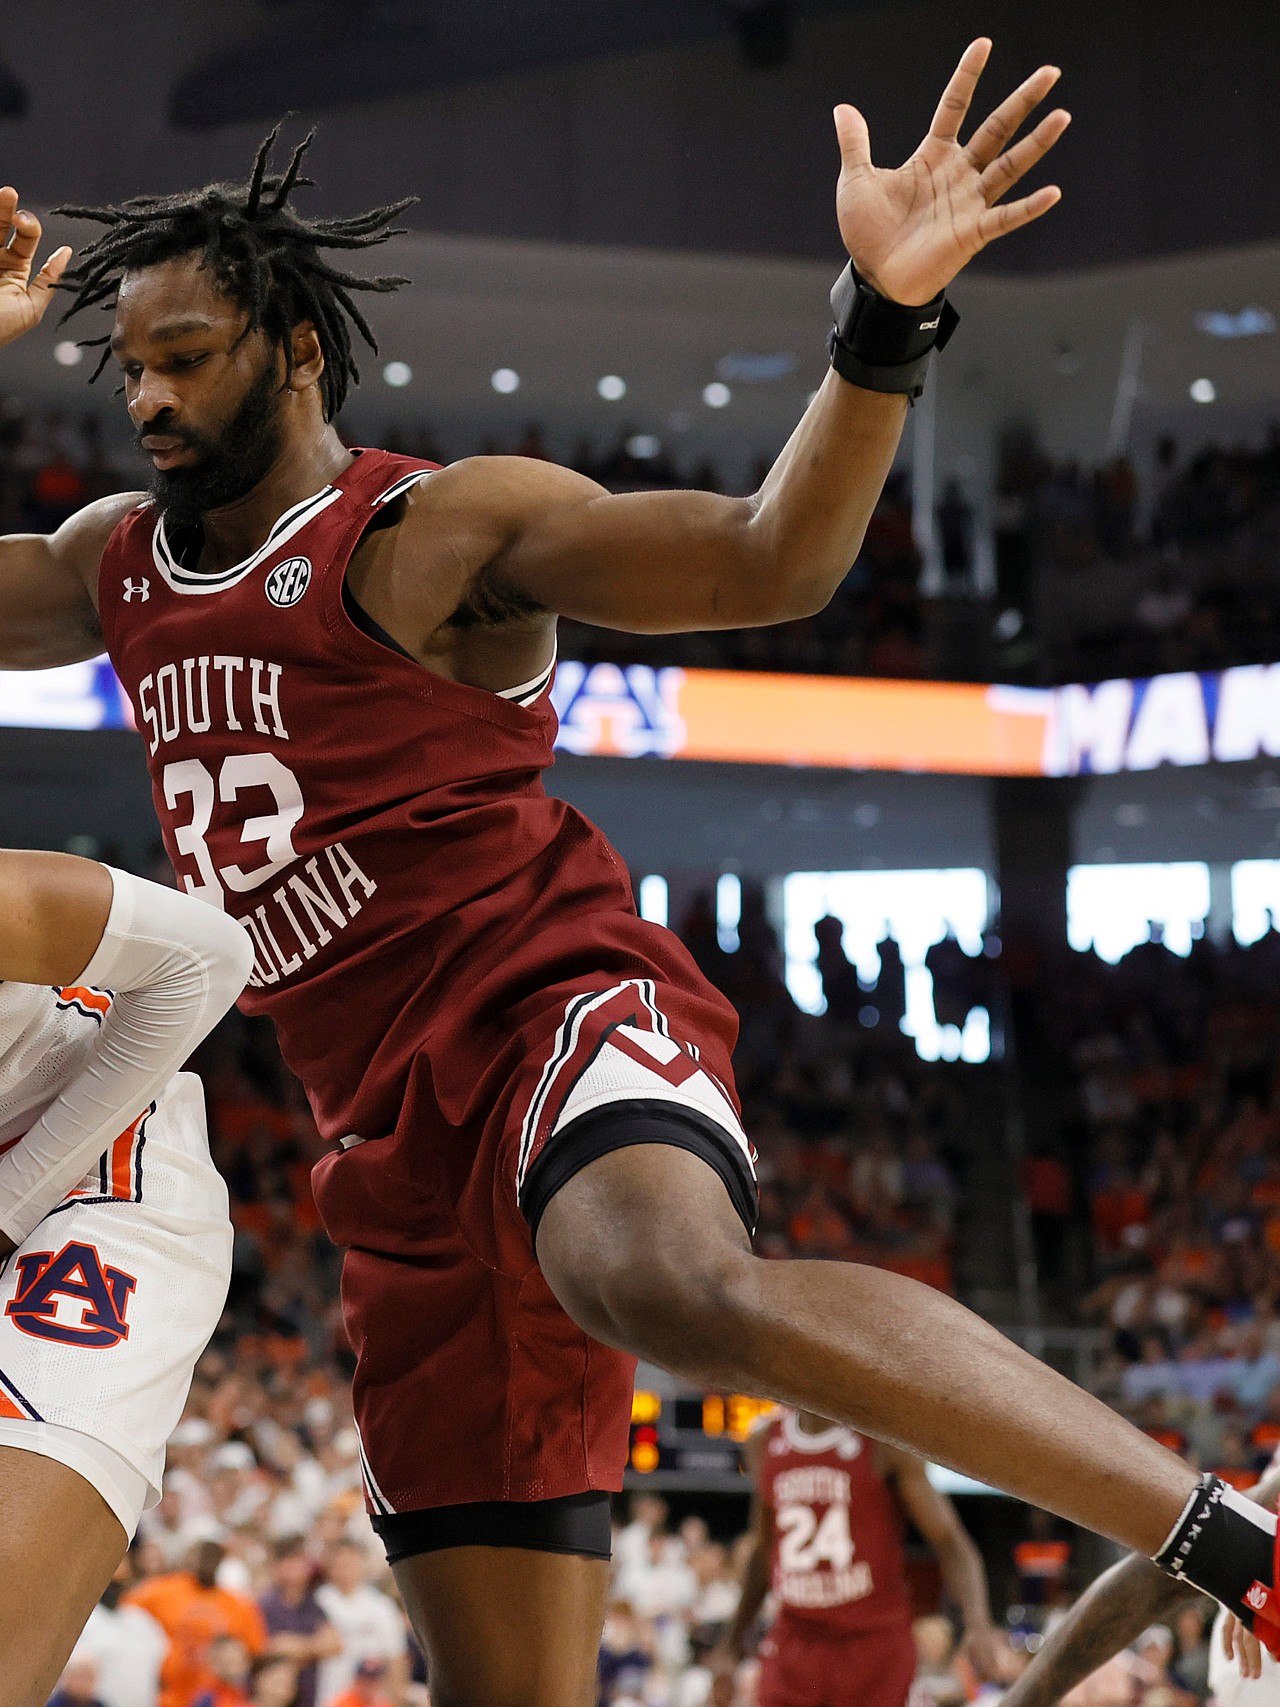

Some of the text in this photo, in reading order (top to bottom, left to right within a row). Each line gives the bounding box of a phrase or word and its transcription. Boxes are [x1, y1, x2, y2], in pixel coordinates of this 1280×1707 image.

[267, 558, 309, 604] SEC
[138, 655, 289, 757] SOUTH
[163, 752, 304, 911] 33
[236, 842, 377, 988] OLINA
[776, 1502, 855, 1572] 24
